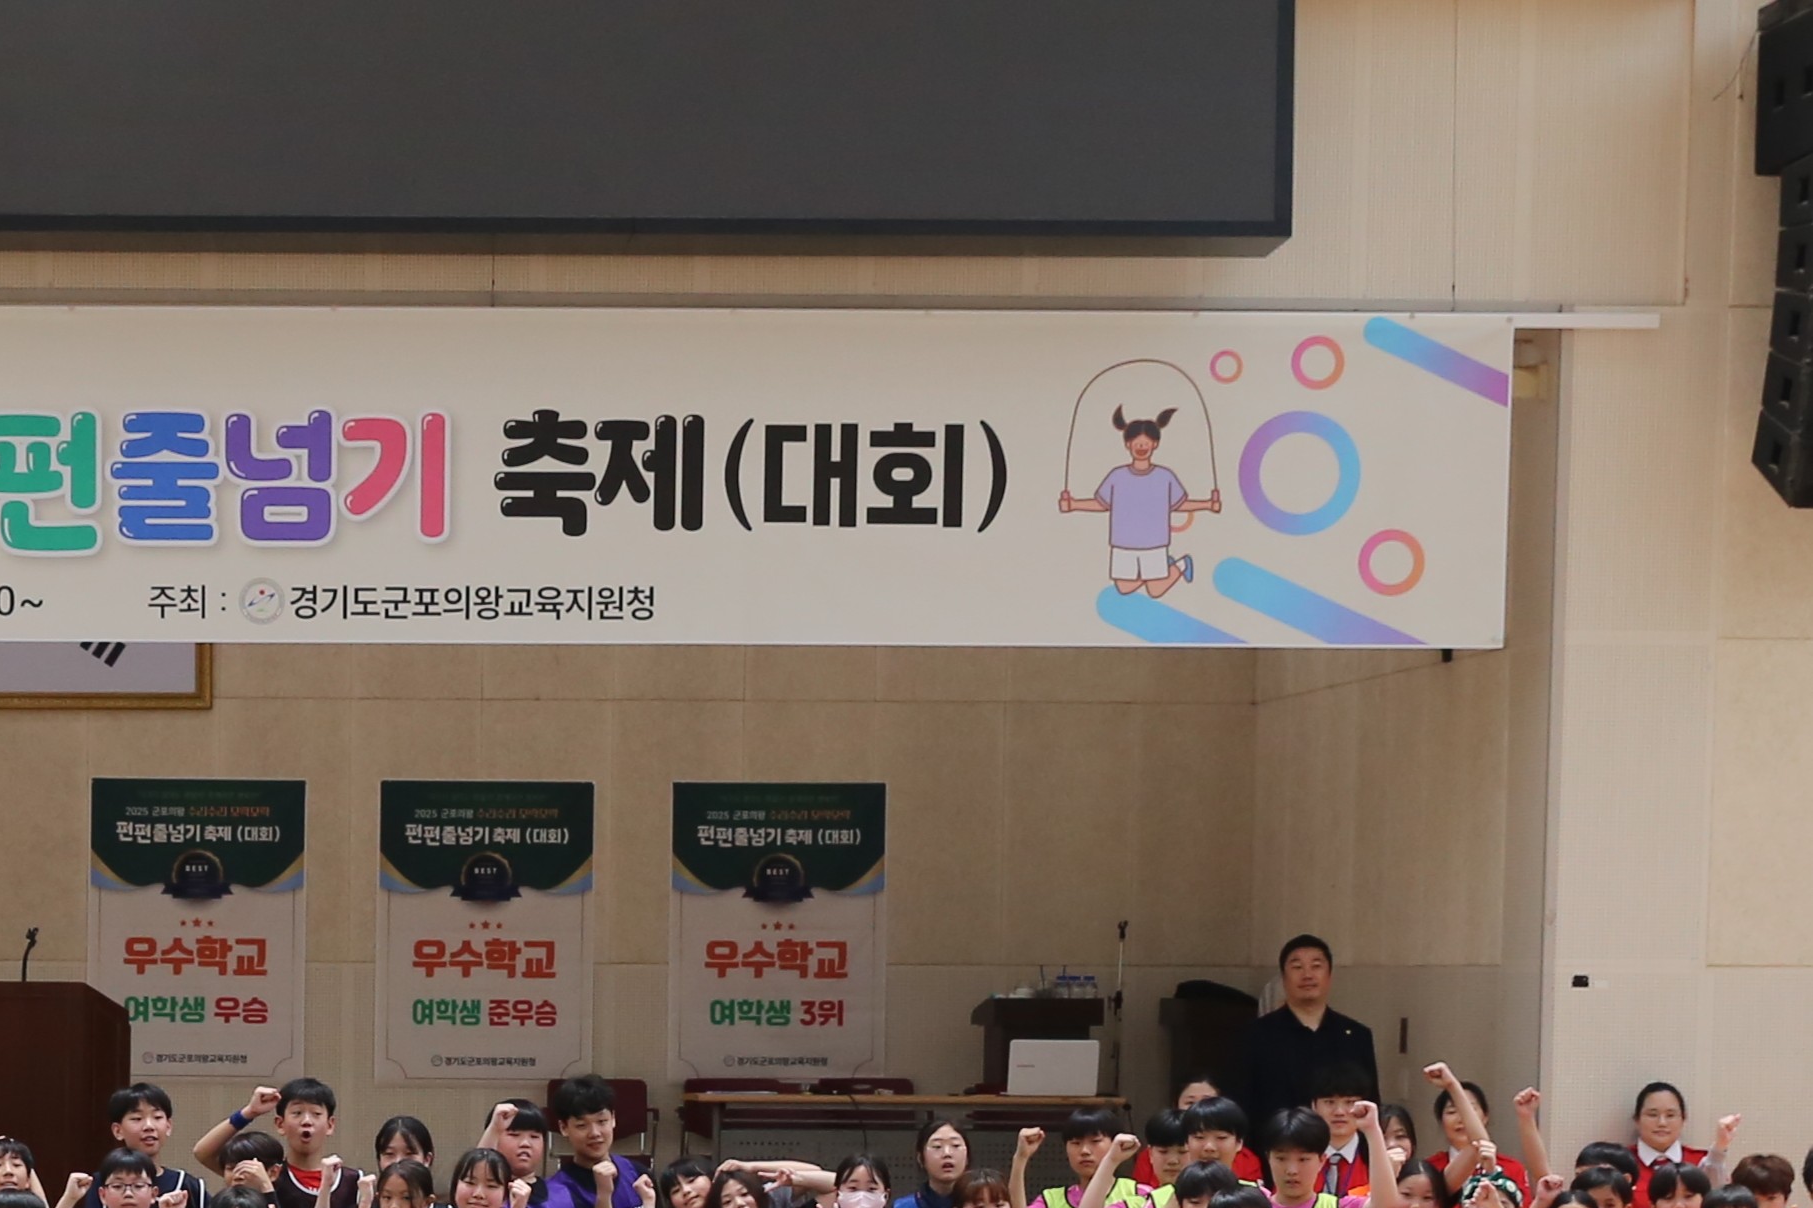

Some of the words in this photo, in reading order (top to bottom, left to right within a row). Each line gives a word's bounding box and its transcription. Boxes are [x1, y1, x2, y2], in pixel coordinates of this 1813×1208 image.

[147, 584, 206, 620] 주최
[289, 584, 655, 621] 경기도군포의왕교육지원청
[116, 821, 201, 844] 편편줄넘기
[204, 826, 232, 842] 축제
[237, 826, 281, 843] (대회)
[405, 823, 489, 847] 편편줄넘기
[493, 828, 521, 845] 축제
[526, 828, 570, 845] (대회)
[697, 824, 782, 848] 편편줄넘기
[785, 829, 813, 846] 축제
[818, 829, 862, 847] (대회)
[123, 935, 268, 976] 우수학교
[412, 938, 557, 979] 우수학교
[704, 939, 848, 979] 우수학교
[124, 996, 206, 1023] 여학생
[214, 996, 268, 1024] 우승
[412, 998, 481, 1026] 여학생
[488, 999, 557, 1027] 준우승
[709, 999, 791, 1026] 여학생
[800, 1000, 844, 1027] 3위
